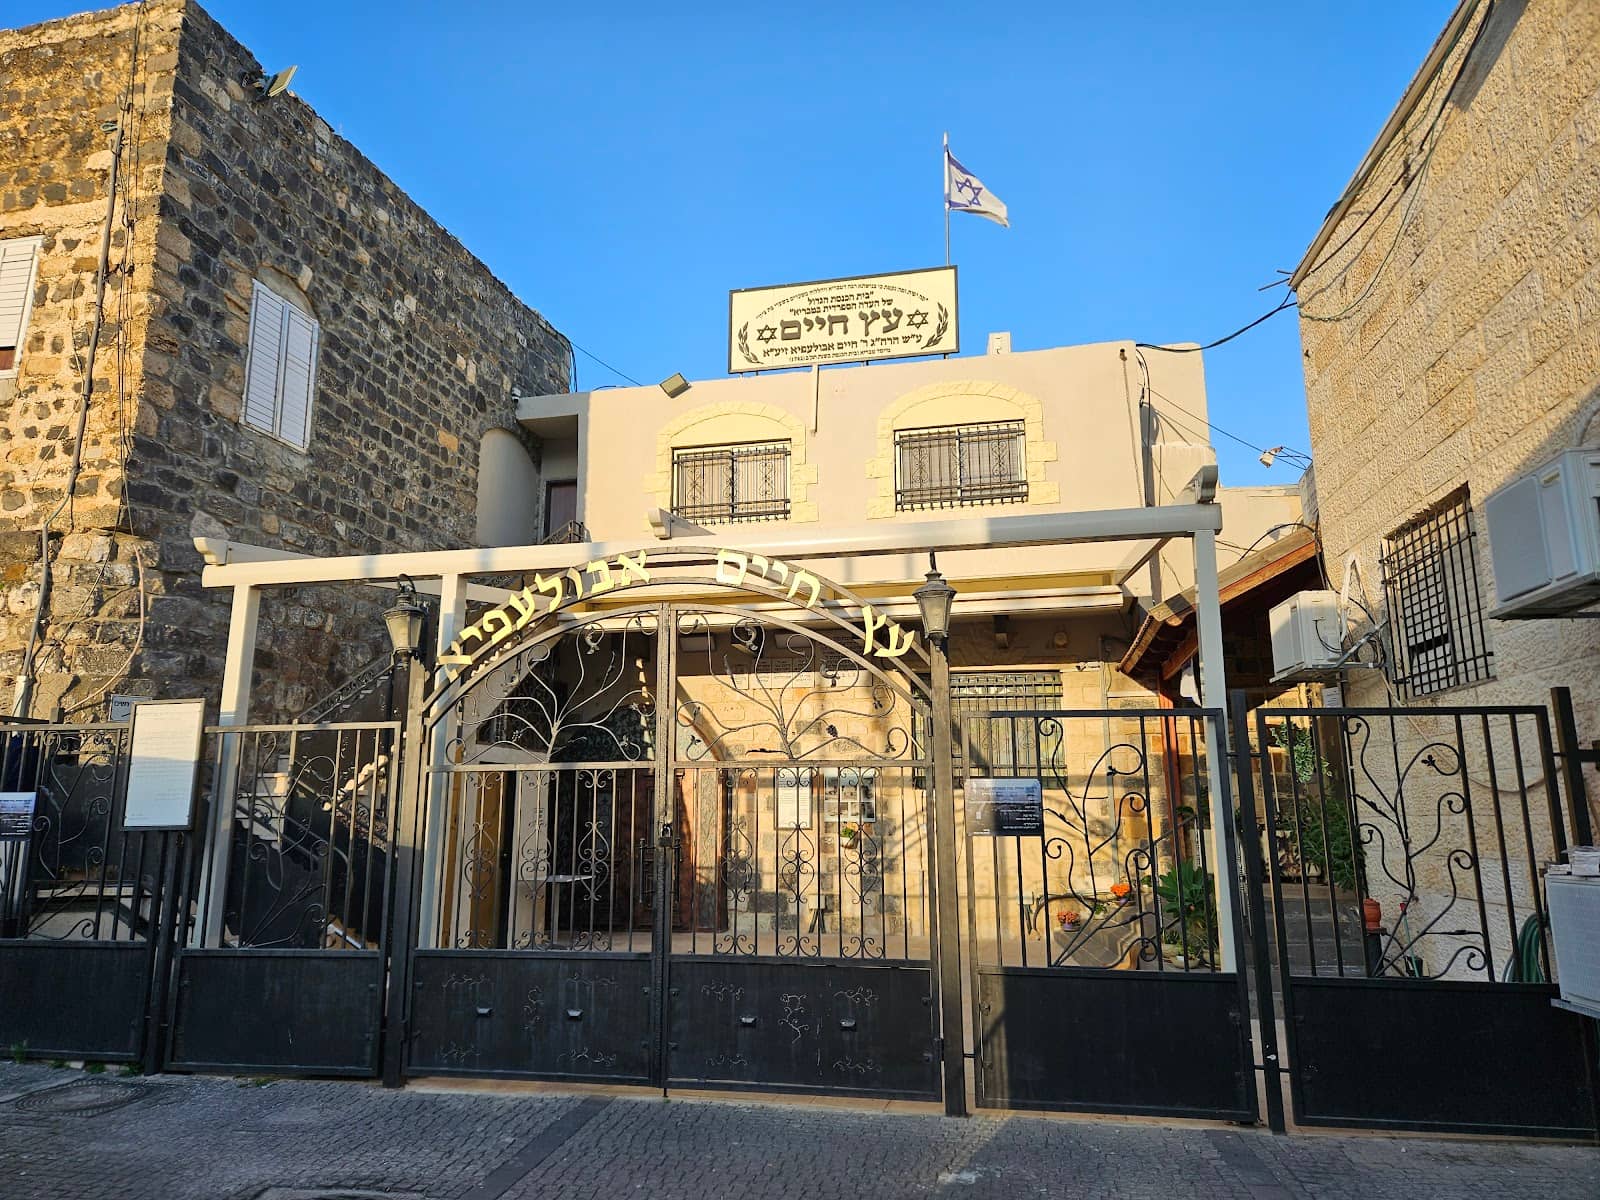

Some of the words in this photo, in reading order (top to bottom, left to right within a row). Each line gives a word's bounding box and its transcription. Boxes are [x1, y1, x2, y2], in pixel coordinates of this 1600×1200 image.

[808, 297, 829, 306] הגדול
[830, 293, 854, 304] הכנסת
[859, 300, 880, 309] העדה
[823, 302, 856, 313] הספרדית
[780, 314, 848, 340] חיים
[858, 308, 903, 336] עץ
[790, 342, 834, 354] אבולעפיא
[837, 340, 858, 350] חיים
[716, 548, 822, 608] חיים
[438, 550, 650, 682] אבולעפיא
[862, 605, 915, 658] עץ
